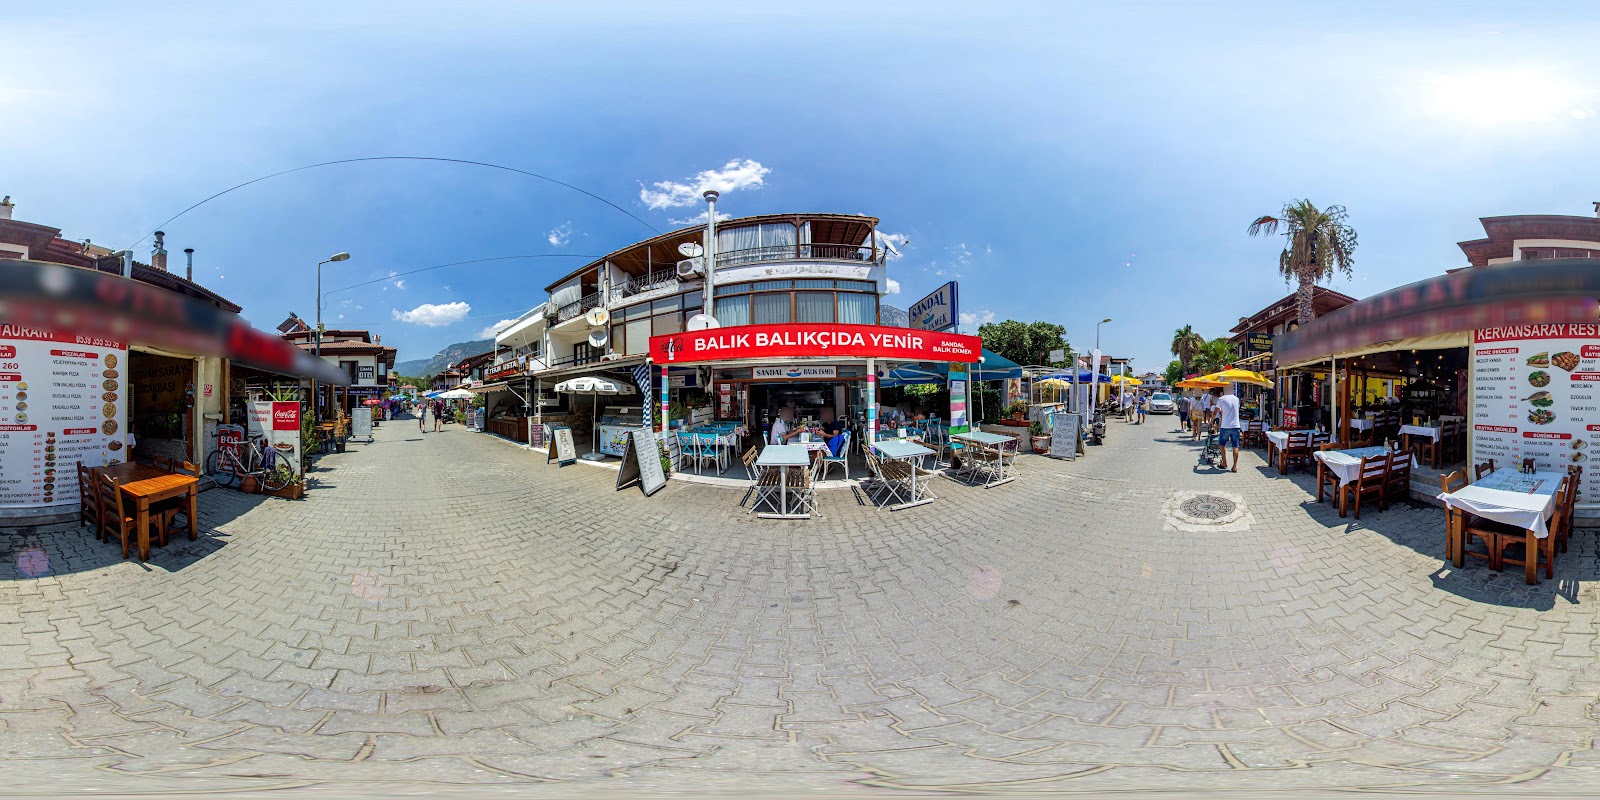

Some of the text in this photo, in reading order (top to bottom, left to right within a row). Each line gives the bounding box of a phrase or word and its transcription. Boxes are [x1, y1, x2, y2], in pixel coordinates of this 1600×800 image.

[912, 290, 946, 322] SANDAL
[0, 324, 53, 338] AURANT
[1478, 324, 1566, 340] KERVANSARAY
[694, 332, 923, 351] BALIK BALIKÇIDA YENİR
[159, 364, 186, 378] SARAY
[275, 410, 297, 418] Coca-Cola
